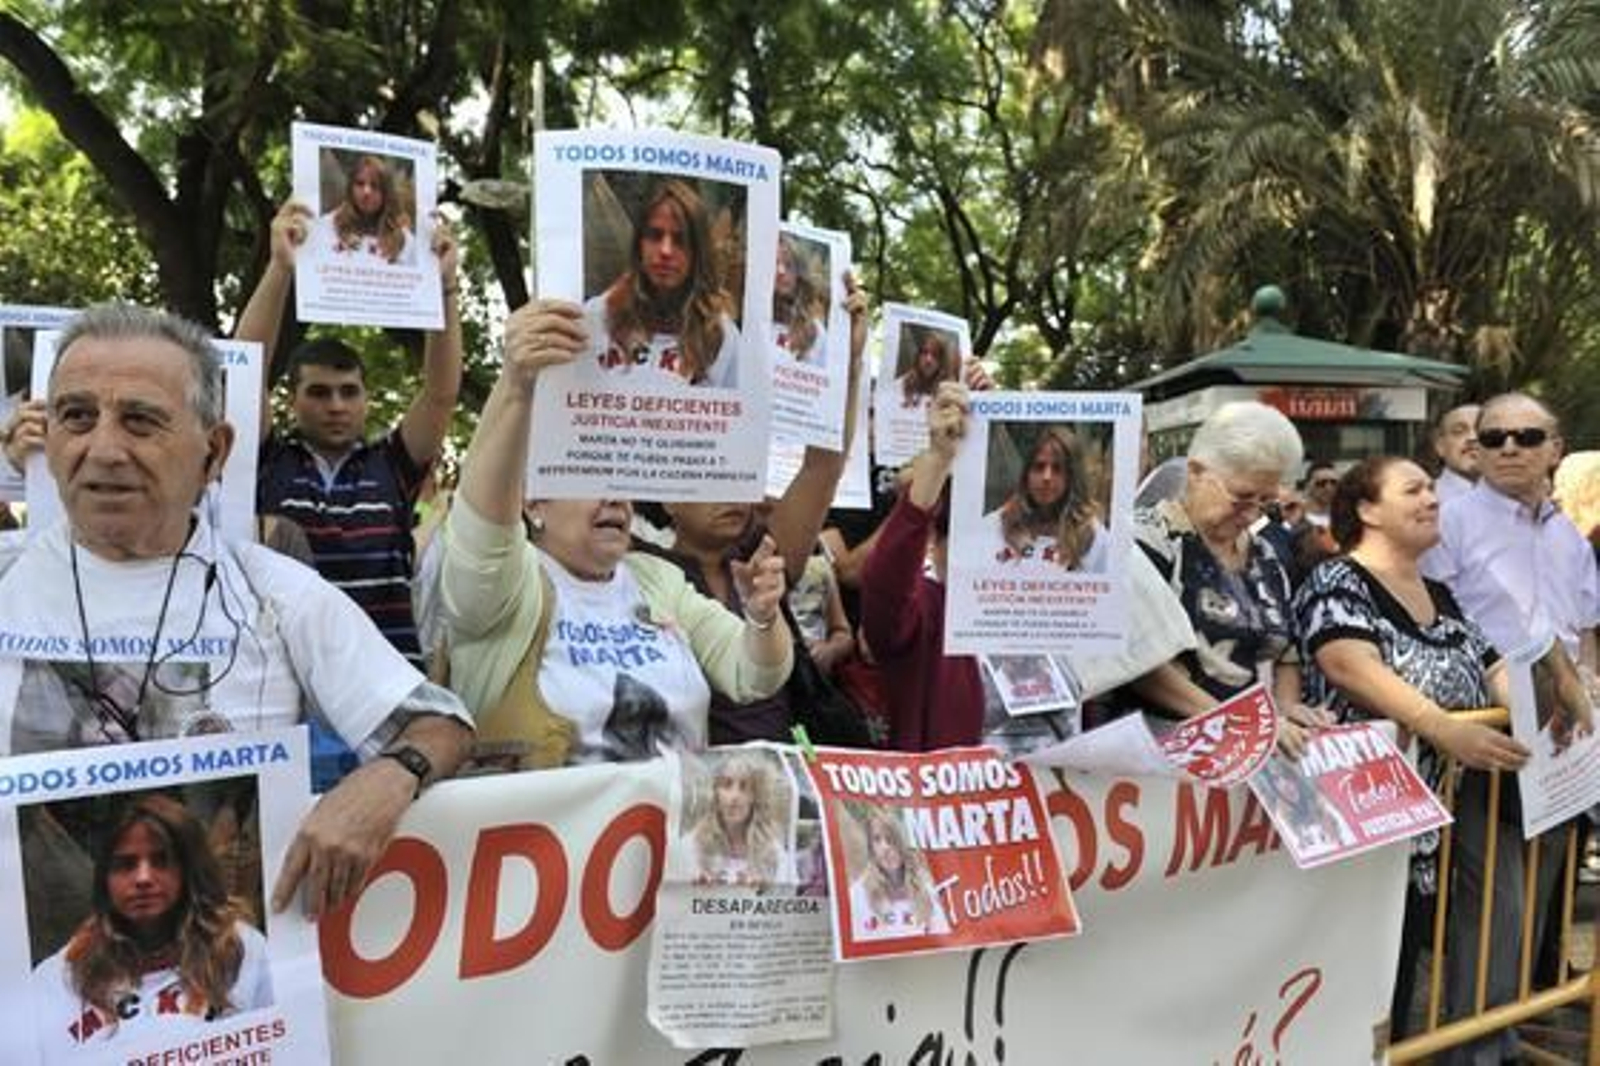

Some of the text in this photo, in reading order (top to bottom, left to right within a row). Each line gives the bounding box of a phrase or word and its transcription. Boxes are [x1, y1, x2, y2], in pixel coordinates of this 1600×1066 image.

[553, 144, 769, 182] TODOS SOMOS MARTA
[567, 392, 743, 417] LEYES DEFICIENTES
[970, 401, 1132, 415] TODOS SOMOS MARTA
[571, 413, 729, 434] JUSTICIA INEXISTENTE
[579, 434, 617, 446] MARTA
[621, 436, 638, 447] NO
[973, 578, 1112, 594] LEYES DEFICIENTES
[166, 637, 238, 657] MART
[86, 753, 184, 784] SOMOS
[190, 741, 290, 773] MARTA
[1301, 729, 1394, 777] MARTA
[822, 758, 1023, 798] TODOS SOMOS
[901, 796, 1040, 850] MARTA
[318, 801, 667, 1001] ODO
[936, 849, 1050, 929] Todos!!
[692, 897, 821, 916] DESAPARECIDA
